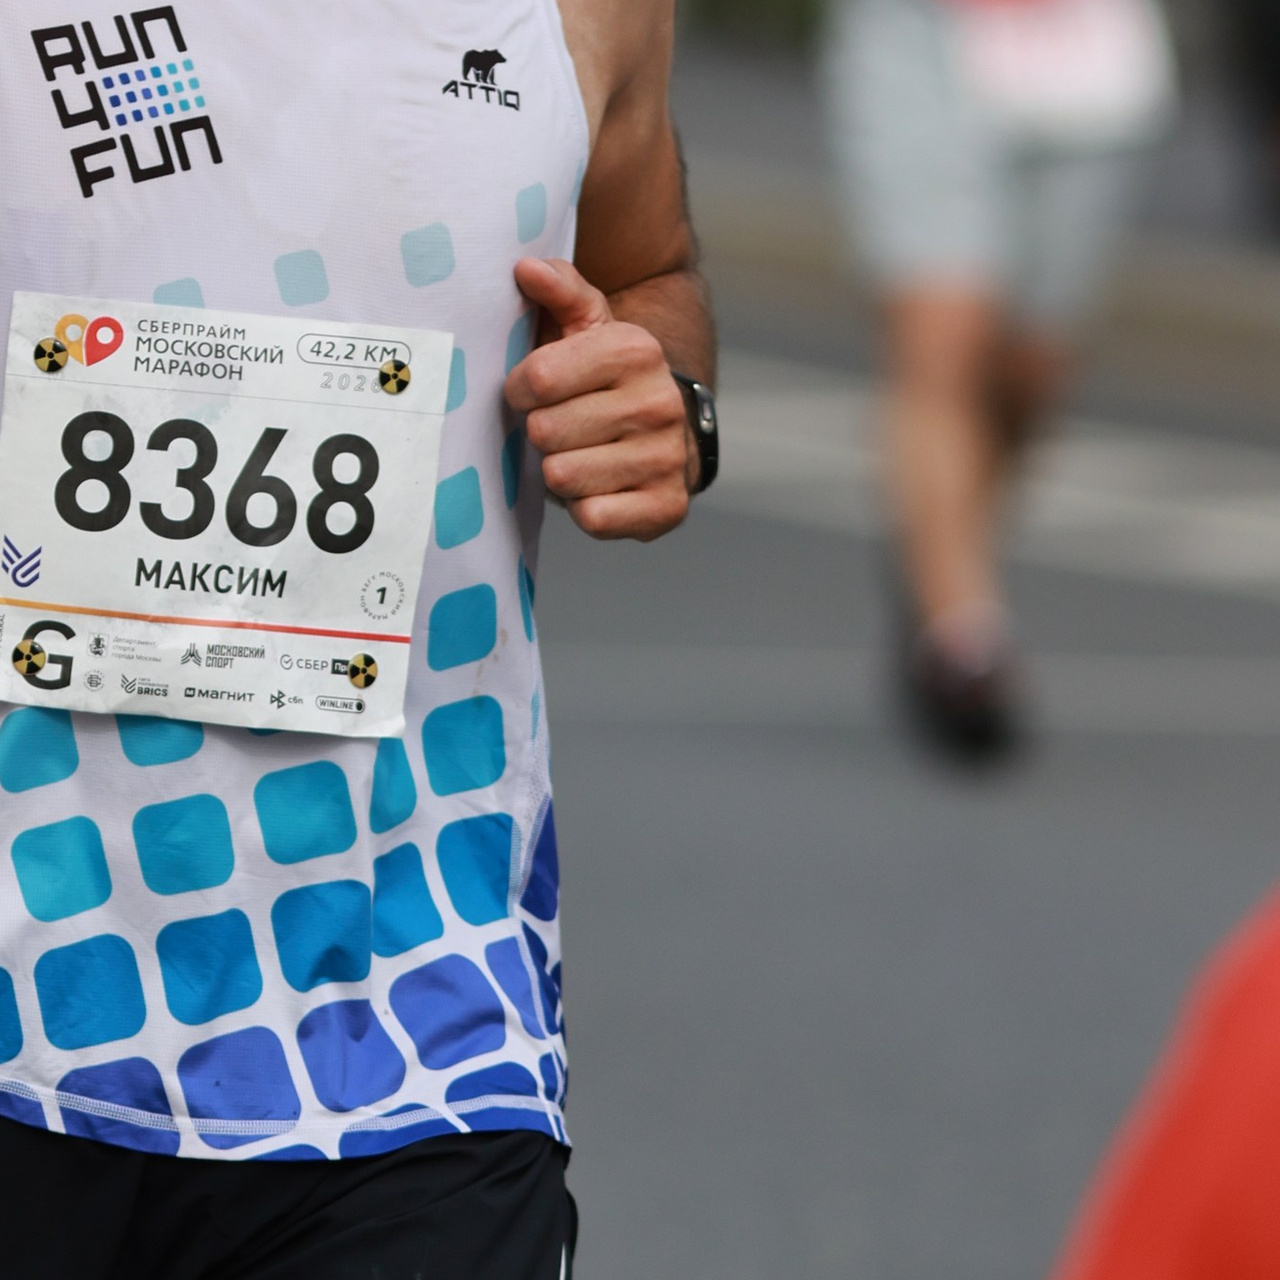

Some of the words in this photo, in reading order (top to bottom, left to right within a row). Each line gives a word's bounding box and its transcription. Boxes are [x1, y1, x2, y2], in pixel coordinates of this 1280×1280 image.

[30, 5, 188, 82] RUN
[51, 81, 111, 131] 4
[442, 79, 520, 111] ATTIQ
[70, 115, 223, 198] FUN
[137, 319, 246, 341] СБЕРПРАЙМ
[135, 336, 284, 365] МОСКОВСКИЙ
[310, 340, 356, 362] 42,2
[134, 356, 243, 381] МАРАФОН
[54, 410, 380, 554] 8368
[135, 557, 288, 599] МАКСИМ
[376, 586, 387, 605] 1
[21, 619, 77, 691] G
[205, 655, 235, 669] СПОРТ
[206, 643, 266, 659] МОСКОВСКИЙ
[296, 658, 329, 671] СБЕР
[137, 686, 169, 697] BRICS
[319, 699, 354, 710] WINLINE
